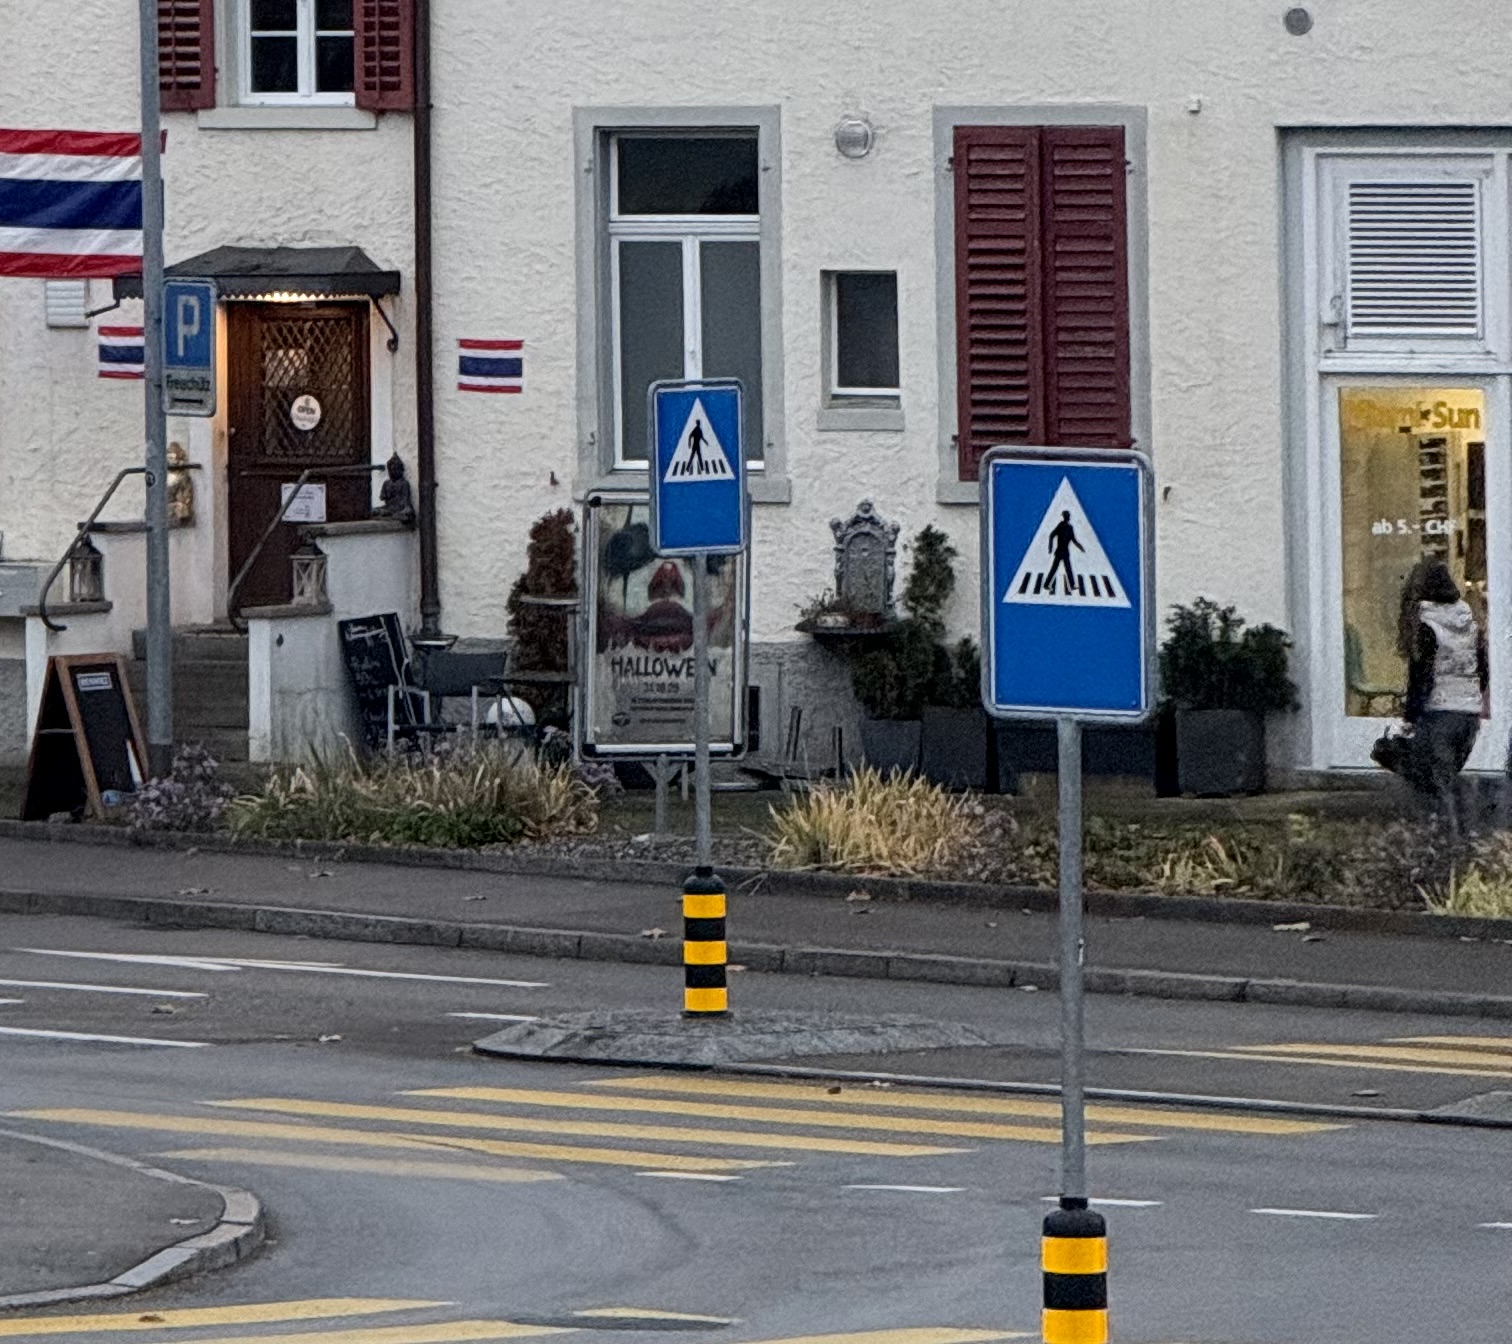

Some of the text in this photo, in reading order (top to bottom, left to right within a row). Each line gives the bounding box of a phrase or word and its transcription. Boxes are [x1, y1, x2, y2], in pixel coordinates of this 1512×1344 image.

[177, 295, 200, 357] P
[1372, 518, 1393, 536] ab
[610, 655, 717, 678] HALLOWEN
